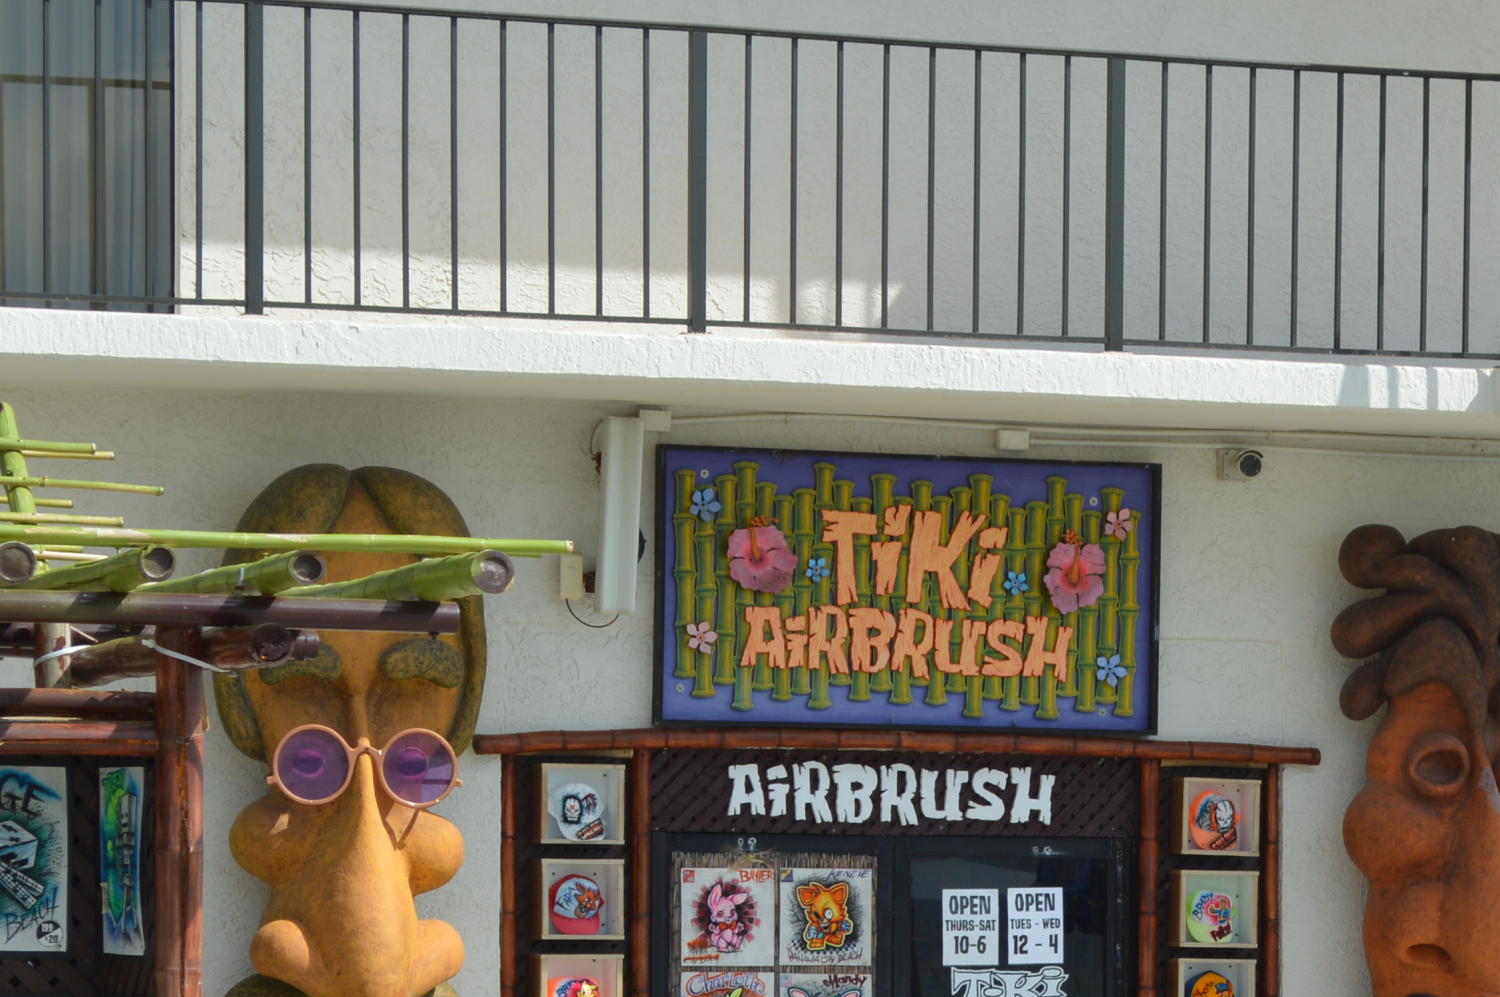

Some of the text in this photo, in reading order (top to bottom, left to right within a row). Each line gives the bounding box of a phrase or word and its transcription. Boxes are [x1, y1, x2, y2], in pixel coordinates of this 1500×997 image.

[949, 895, 991, 915] OPEN
[1014, 893, 1056, 912] OPEN
[944, 919, 996, 931] THURS-SAT
[1010, 918, 1032, 929] TUES
[1042, 918, 1061, 929] WED
[953, 935, 987, 954] 10-6
[1012, 934, 1029, 955] 12
[1049, 934, 1059, 954] 4
